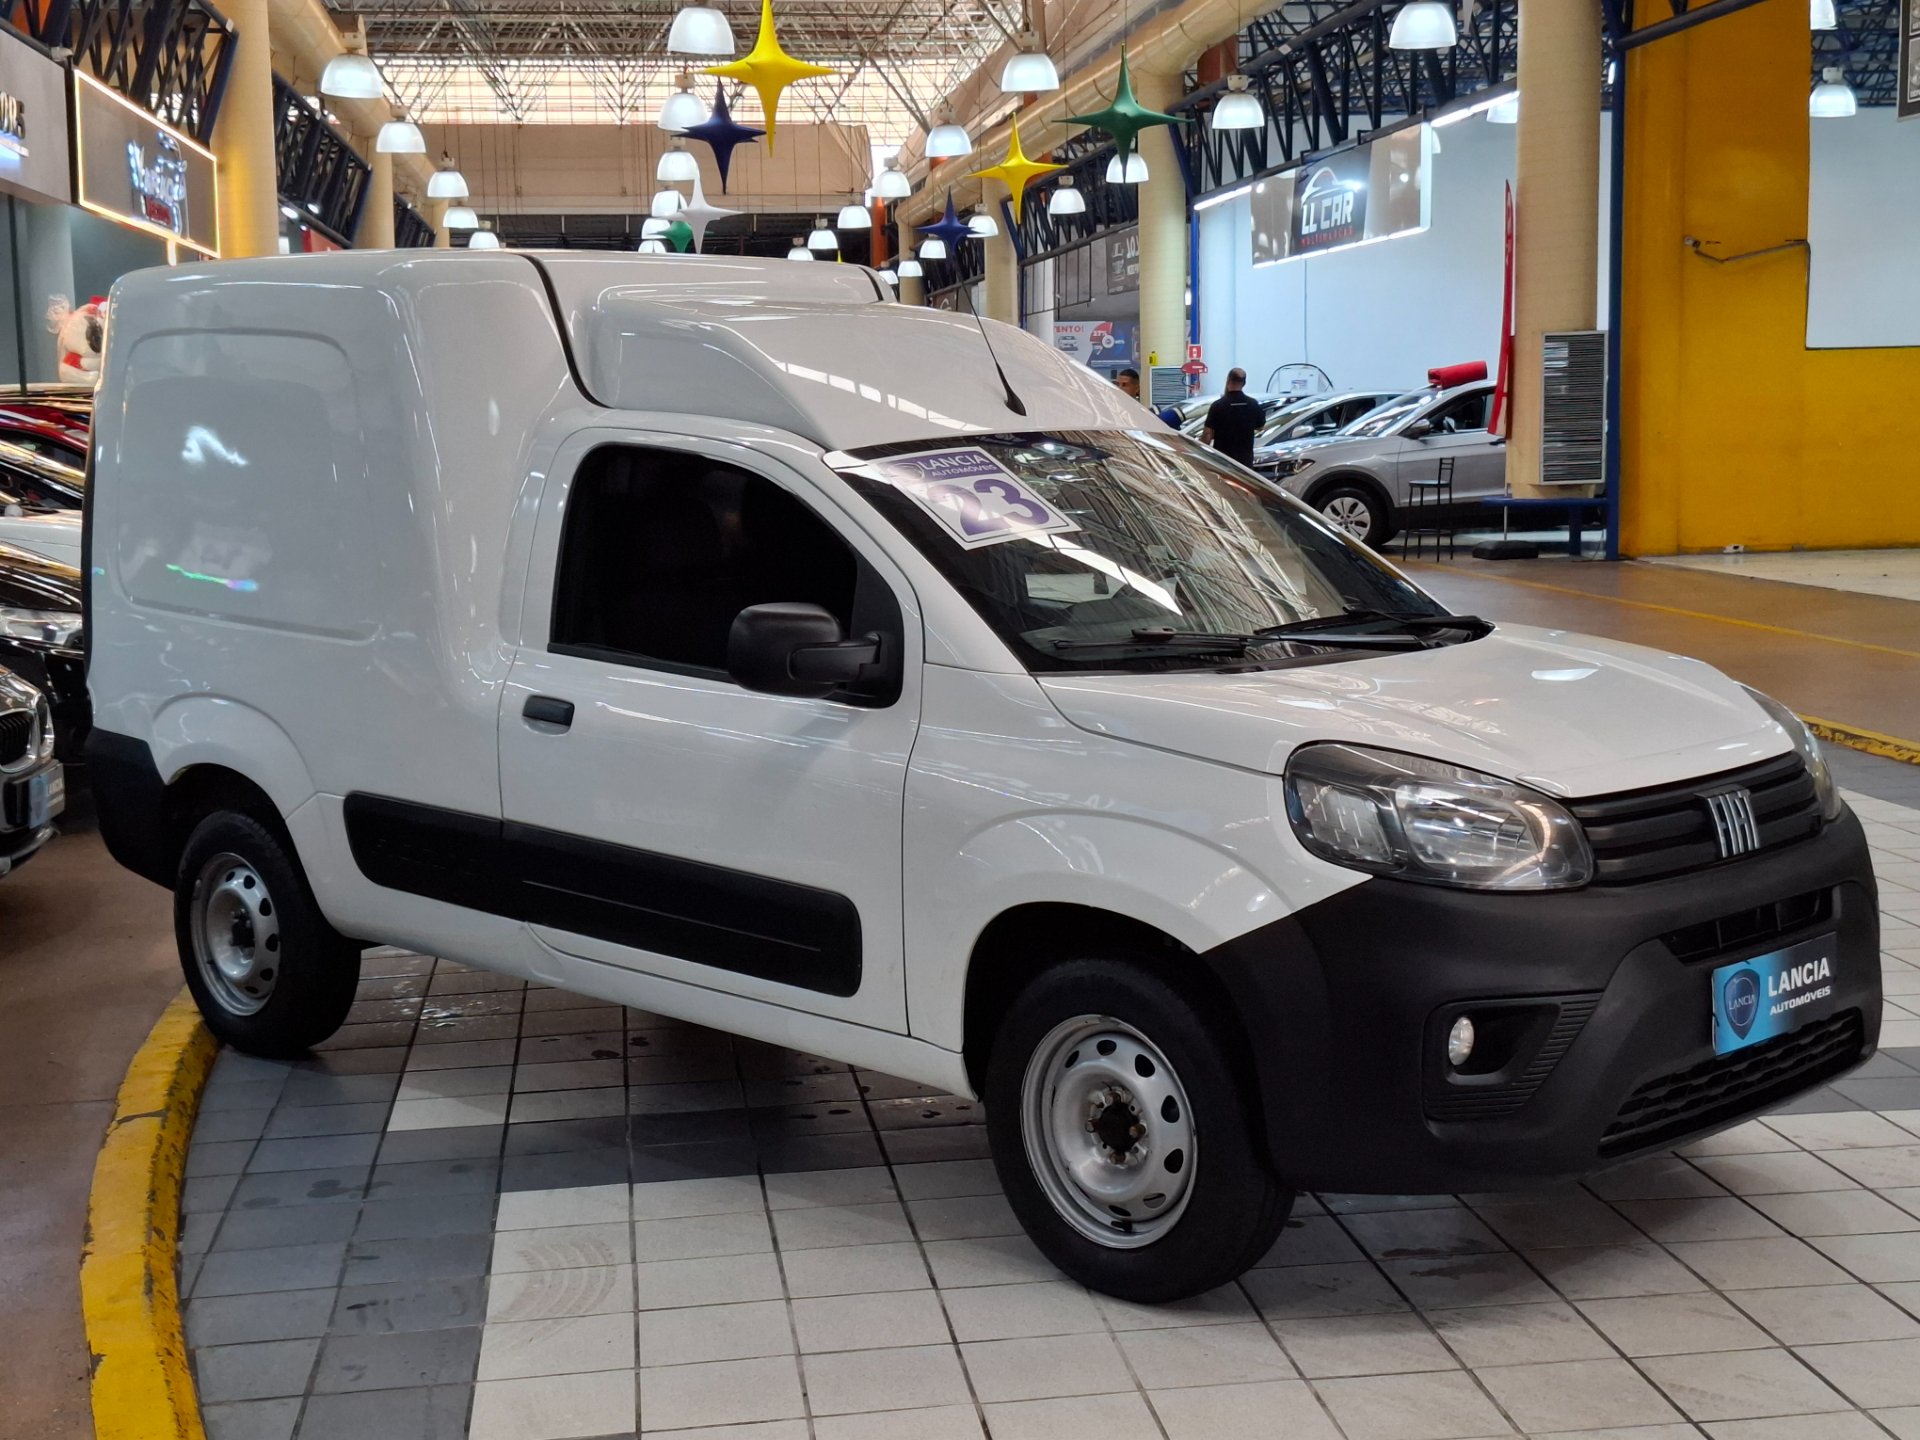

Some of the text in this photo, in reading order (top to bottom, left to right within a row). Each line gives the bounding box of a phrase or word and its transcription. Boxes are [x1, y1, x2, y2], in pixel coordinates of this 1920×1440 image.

[1320, 191, 1354, 229] CAR
[1054, 324, 1084, 333] ENTO!
[918, 454, 989, 470] LANCIA
[927, 479, 1050, 536] 23
[1707, 789, 1760, 858] FIAT
[1768, 956, 1831, 998] LANCIA
[1728, 994, 1756, 1010] LANCIA
[1769, 985, 1831, 1016] AUTOMÓVEIS
